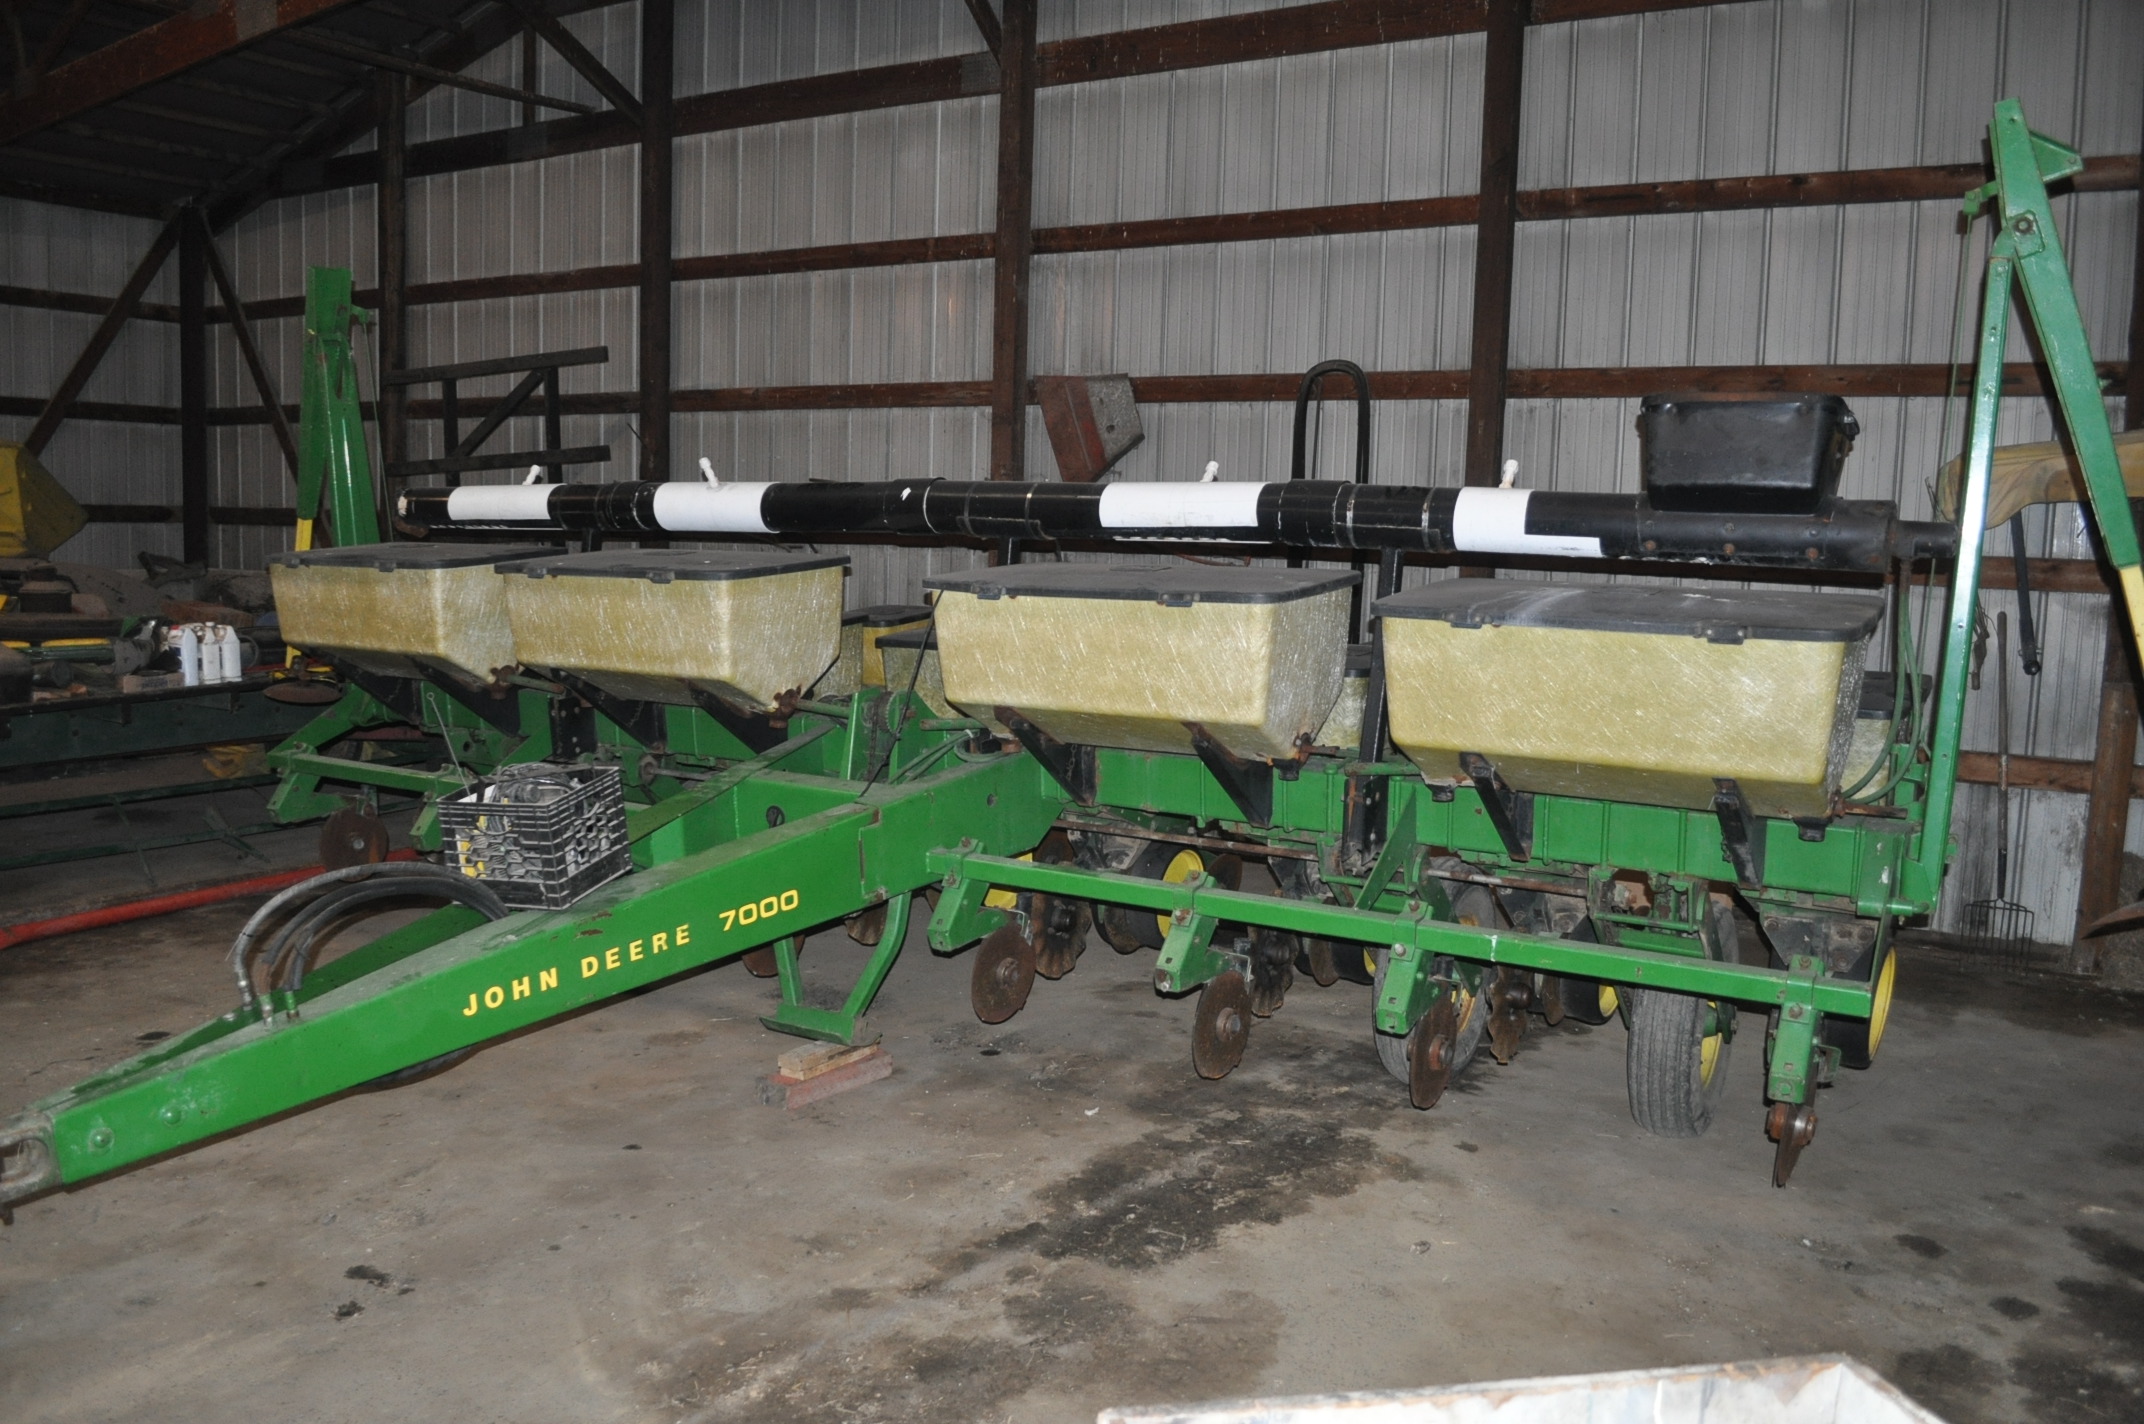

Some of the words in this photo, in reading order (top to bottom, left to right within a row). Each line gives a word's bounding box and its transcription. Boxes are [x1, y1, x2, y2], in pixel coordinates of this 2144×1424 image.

[462, 966, 559, 1017] JOHN
[580, 923, 692, 979] DEERE
[718, 889, 800, 932] 7000
